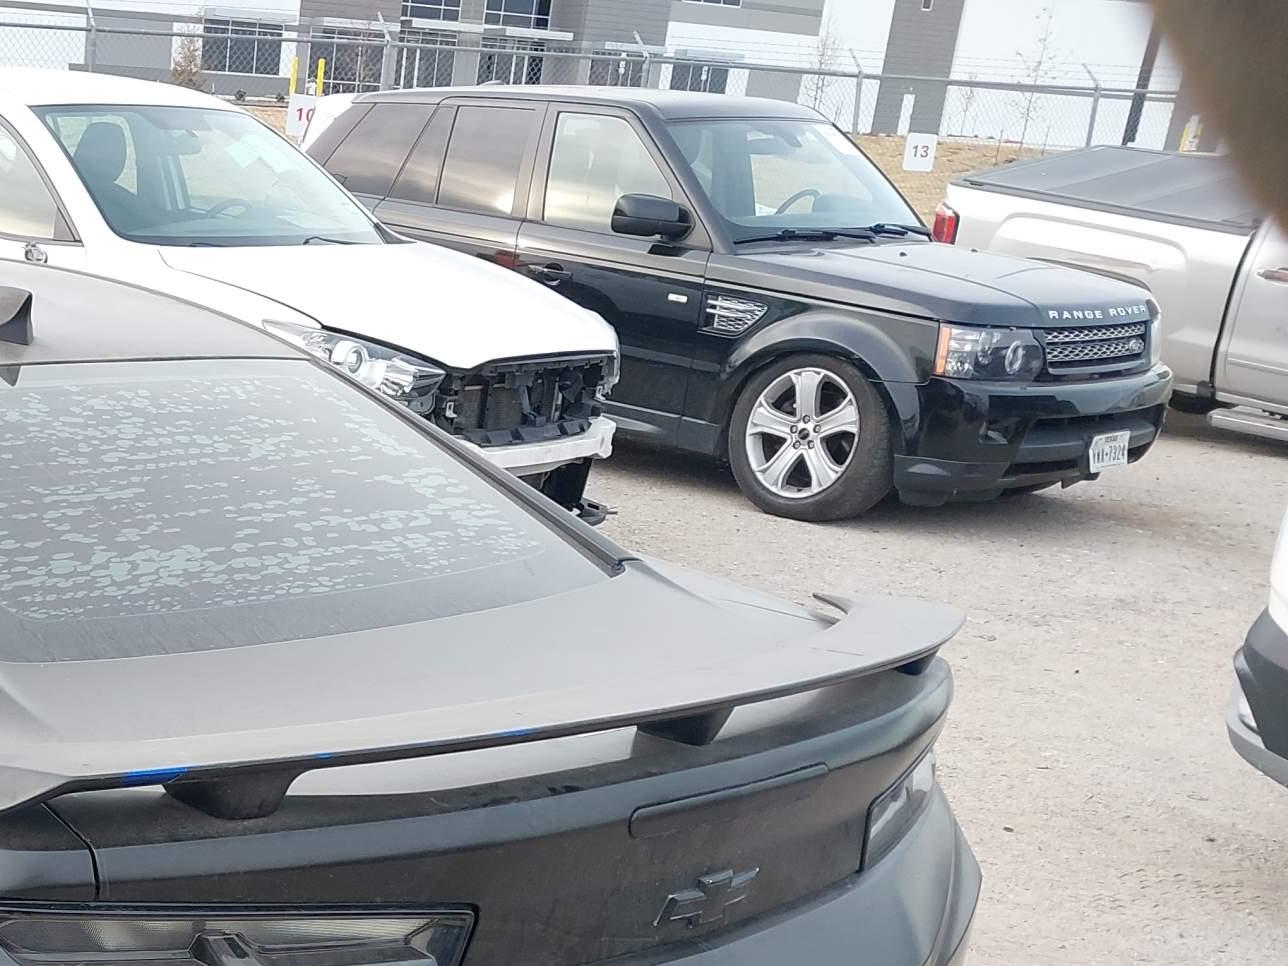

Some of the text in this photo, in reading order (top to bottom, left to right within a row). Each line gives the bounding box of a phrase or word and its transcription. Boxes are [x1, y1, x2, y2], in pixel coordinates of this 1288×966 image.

[912, 145, 929, 158] 13
[1048, 304, 1146, 319] RANGE ROVER
